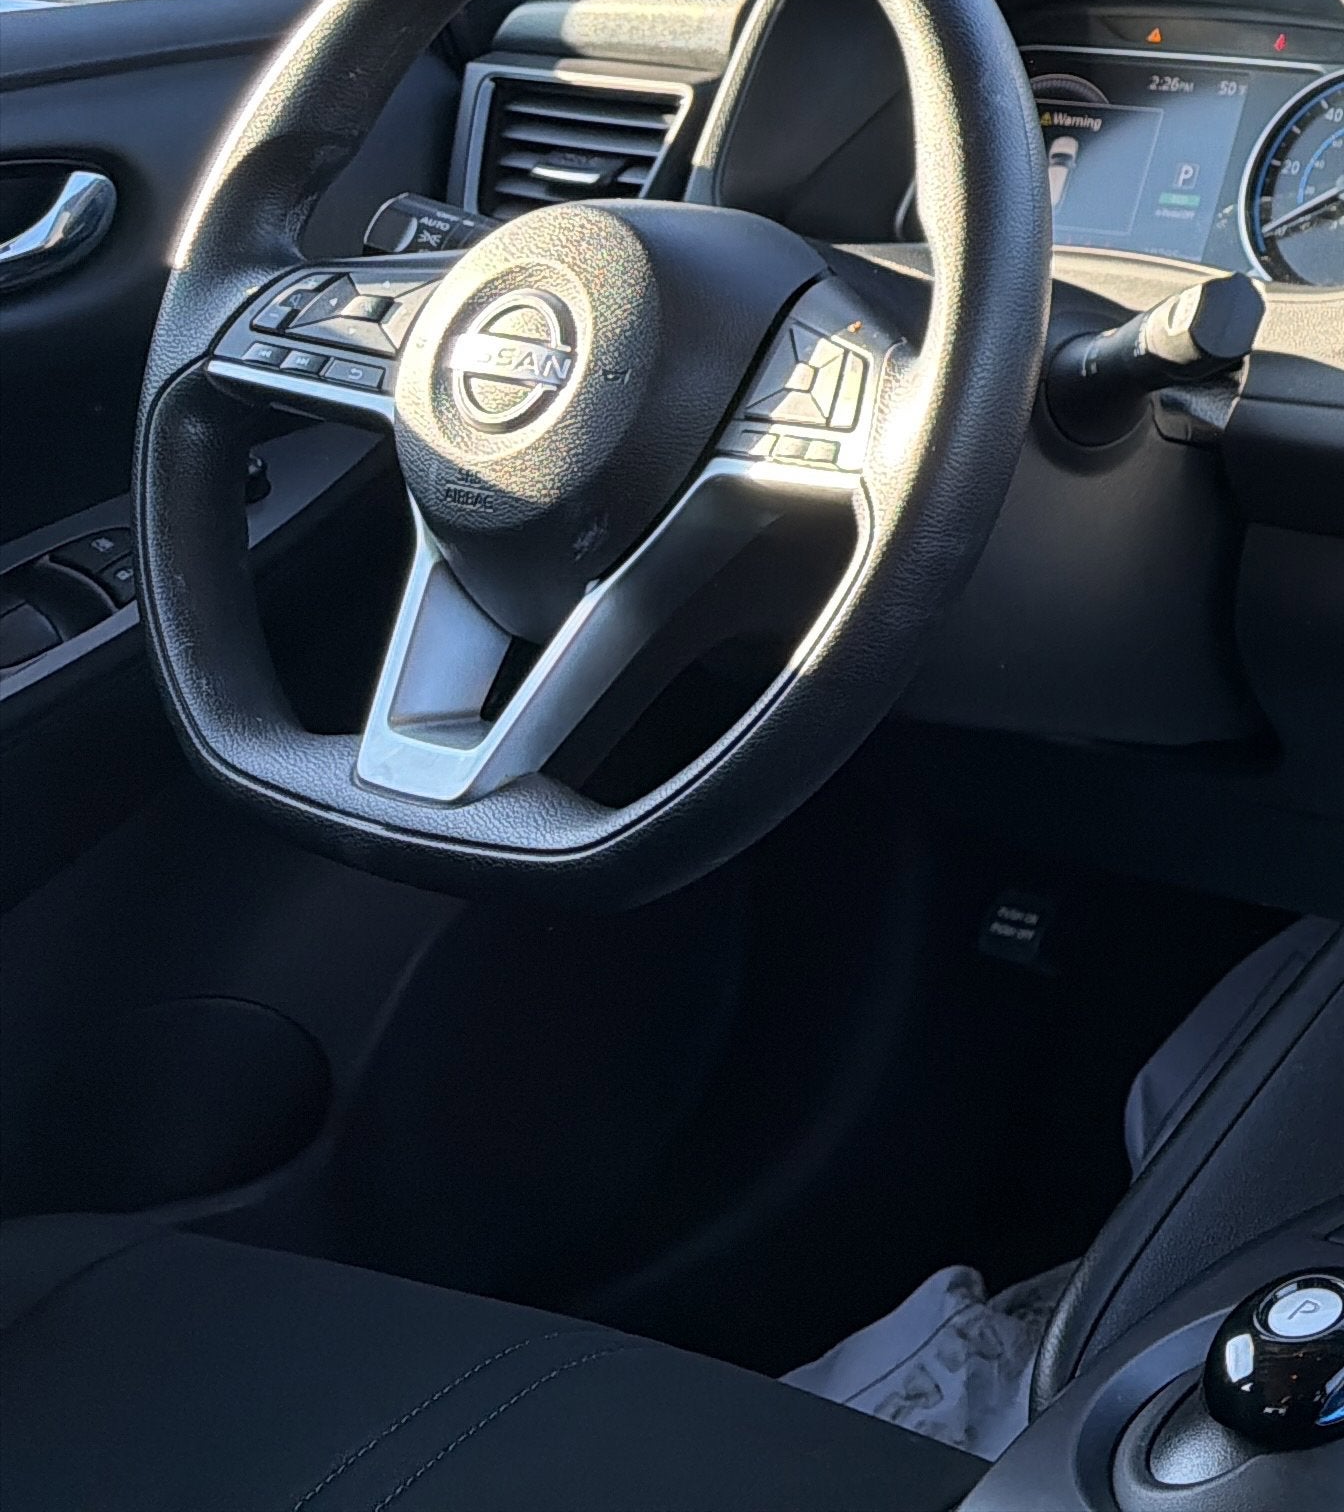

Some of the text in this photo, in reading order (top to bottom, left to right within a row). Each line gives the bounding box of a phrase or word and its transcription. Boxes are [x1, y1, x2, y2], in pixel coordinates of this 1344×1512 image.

[1053, 112, 1103, 132] Warning
[1325, 108, 1344, 123] 40
[1178, 164, 1194, 189] P
[1281, 159, 1301, 176] 20
[419, 216, 451, 232] AUTO
[1287, 1298, 1322, 1321] P
